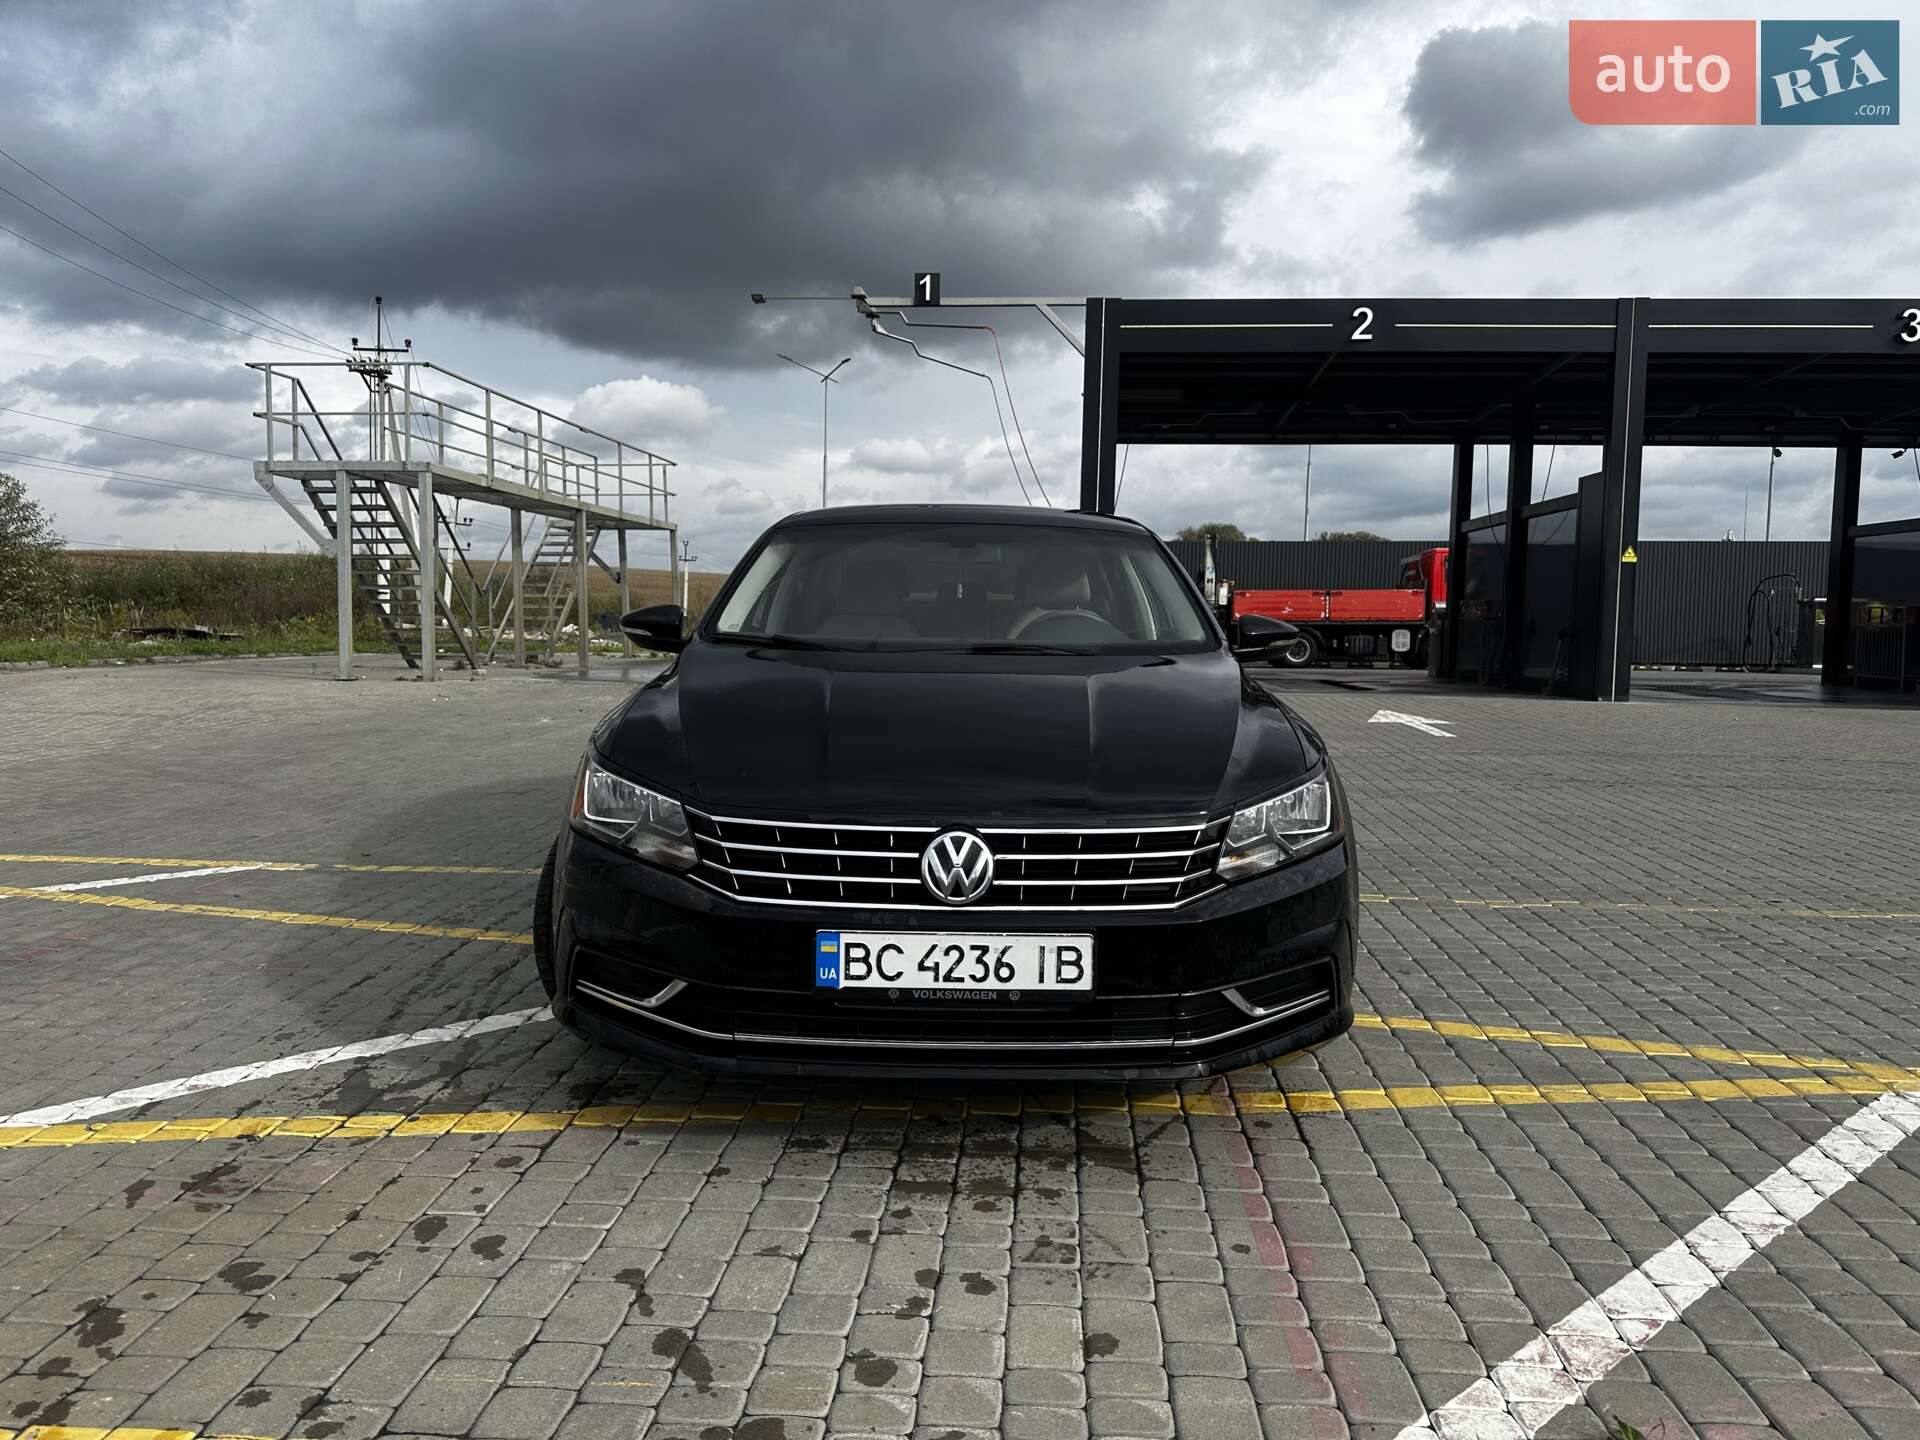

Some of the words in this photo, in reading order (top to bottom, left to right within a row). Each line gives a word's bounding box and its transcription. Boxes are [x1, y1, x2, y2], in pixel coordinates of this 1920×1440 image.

[918, 274, 932, 301] 1
[1350, 306, 1375, 341] 2
[1900, 308, 1920, 343] 3
[820, 967, 838, 980] UA
[843, 942, 905, 982] BC
[917, 943, 1016, 984] 4236
[1037, 945, 1085, 985] IB
[911, 989, 998, 1001] VOLKSWAGEN
